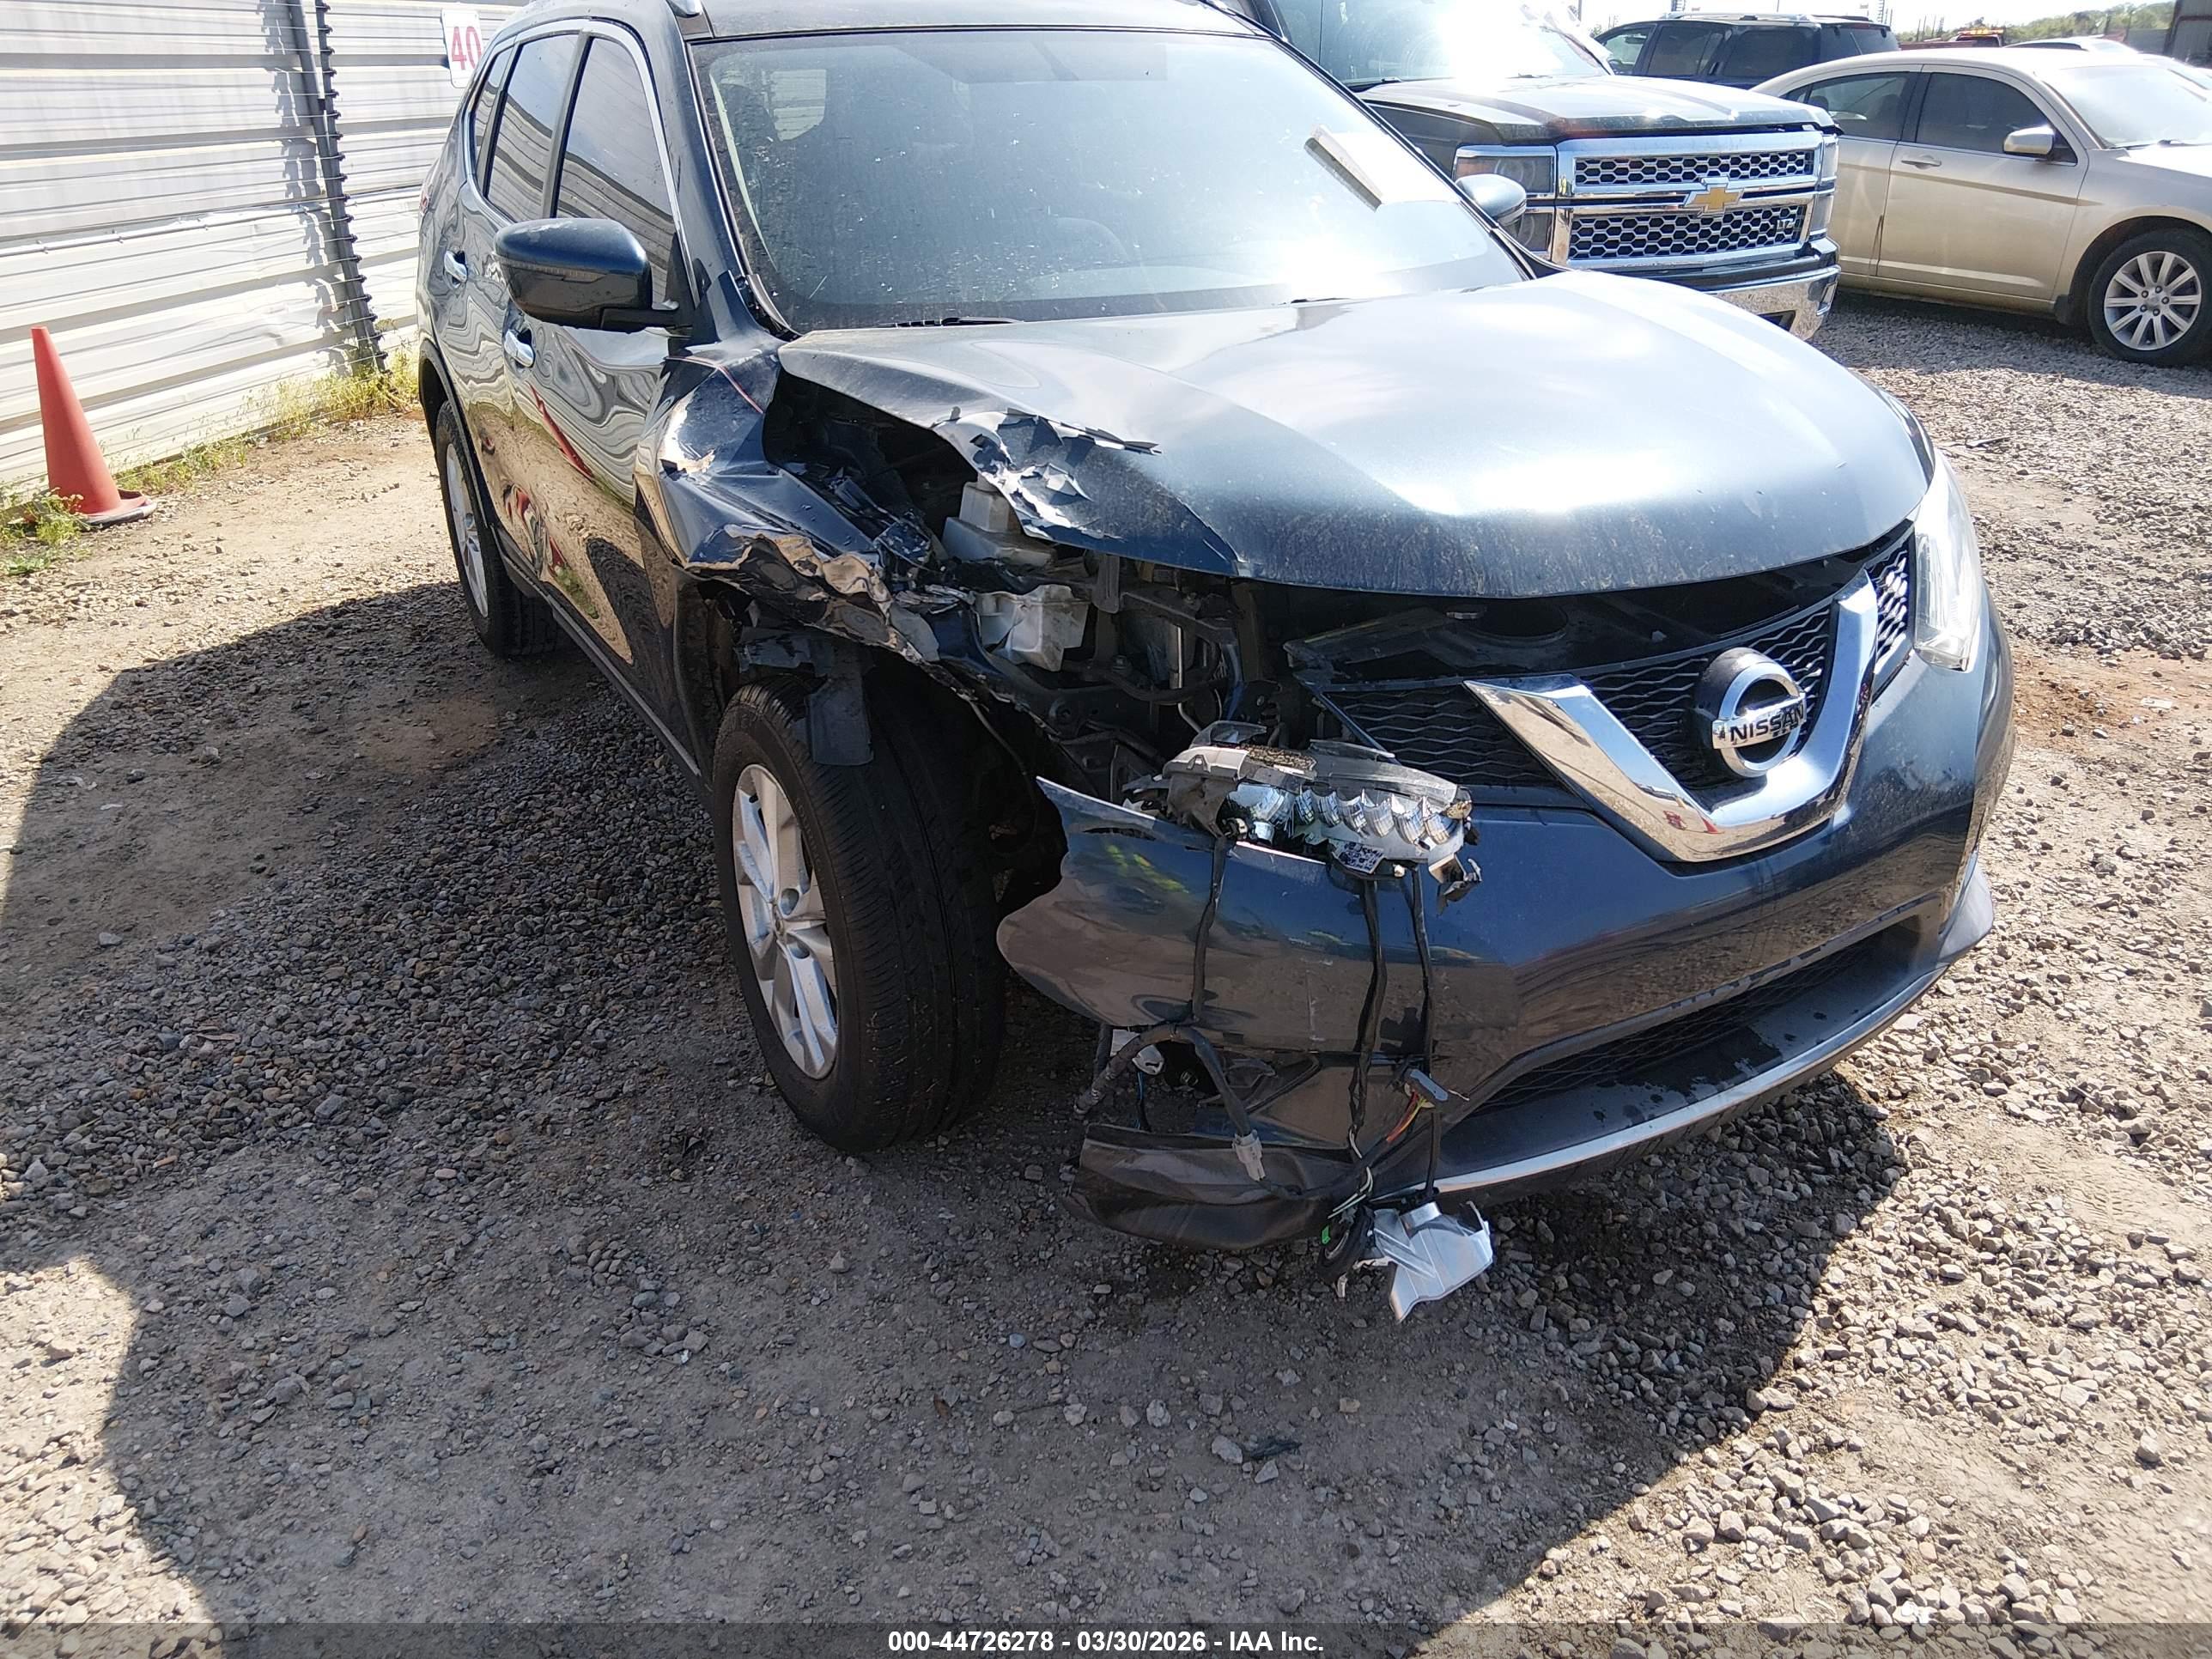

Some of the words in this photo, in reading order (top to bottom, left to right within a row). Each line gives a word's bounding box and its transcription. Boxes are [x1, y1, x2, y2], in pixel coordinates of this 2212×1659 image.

[452, 26, 483, 70] 40
[1776, 218, 1794, 230] LTZ
[1729, 701, 1804, 743] NISSAN
